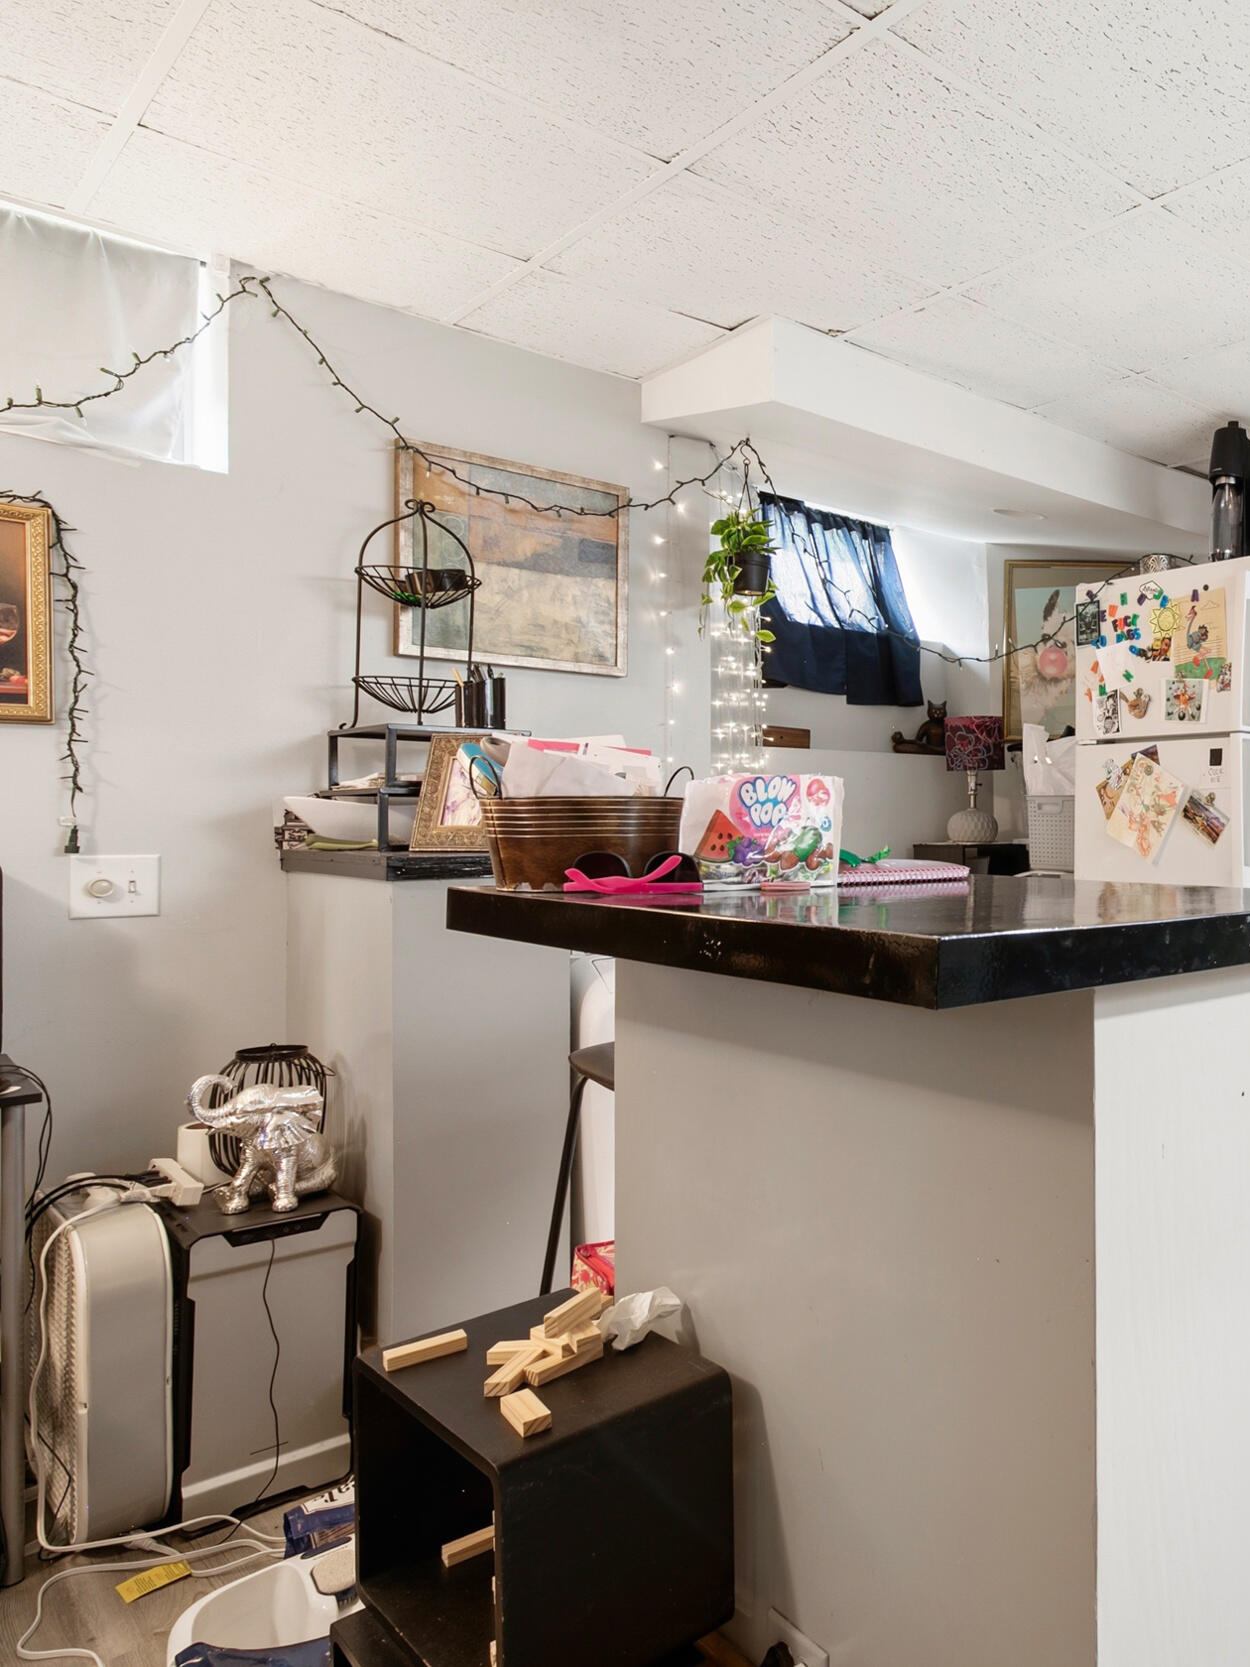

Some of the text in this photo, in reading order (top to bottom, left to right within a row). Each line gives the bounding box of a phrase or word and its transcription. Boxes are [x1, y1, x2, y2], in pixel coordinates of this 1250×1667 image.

[1112, 613, 1140, 632] FUCK
[739, 775, 797, 807] BLOW
[750, 802, 787, 828] POP
